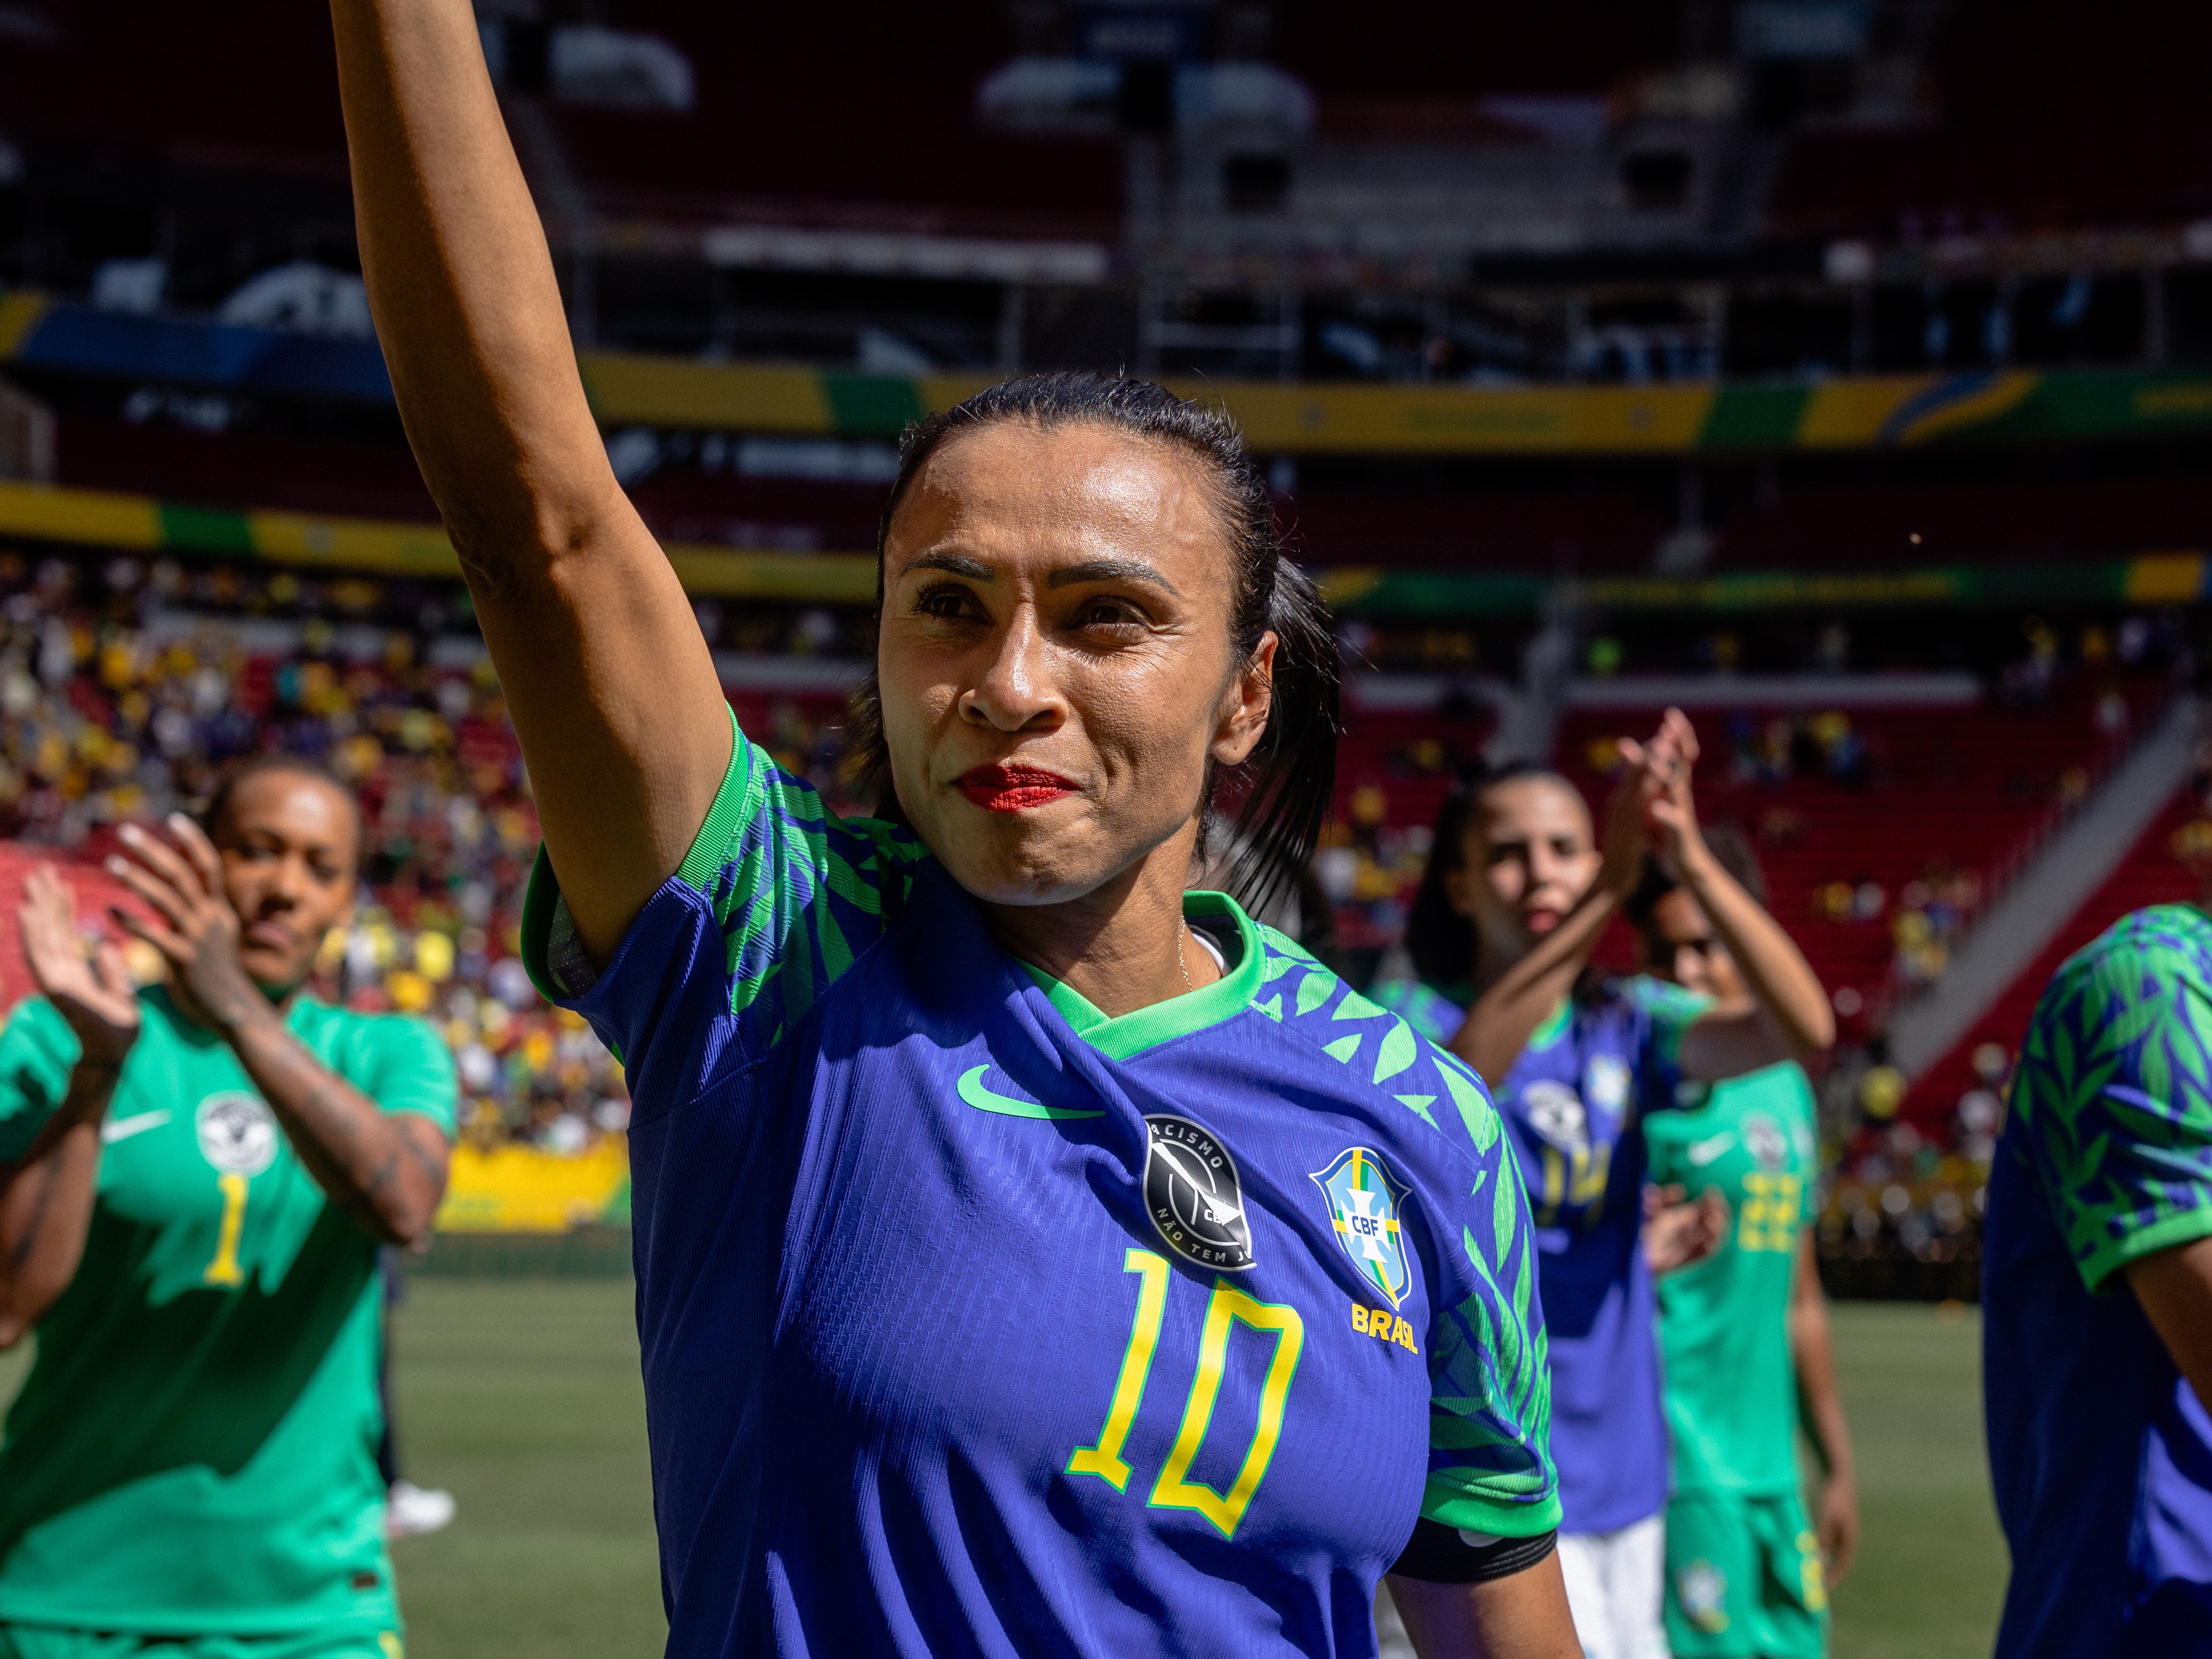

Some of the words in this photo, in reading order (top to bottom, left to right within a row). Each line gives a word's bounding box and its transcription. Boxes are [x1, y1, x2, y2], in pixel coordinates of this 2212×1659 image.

[1151, 1124, 1223, 1168] ACISMO
[202, 1172, 250, 1289] 1
[1157, 1208, 1183, 1241] NÃO
[1191, 1243, 1226, 1263] TEM
[1203, 1209, 1225, 1226] CB
[1351, 1215, 1379, 1236] CBF
[1351, 1303, 1418, 1355] BRASIL
[1063, 1247, 1305, 1541] 10
